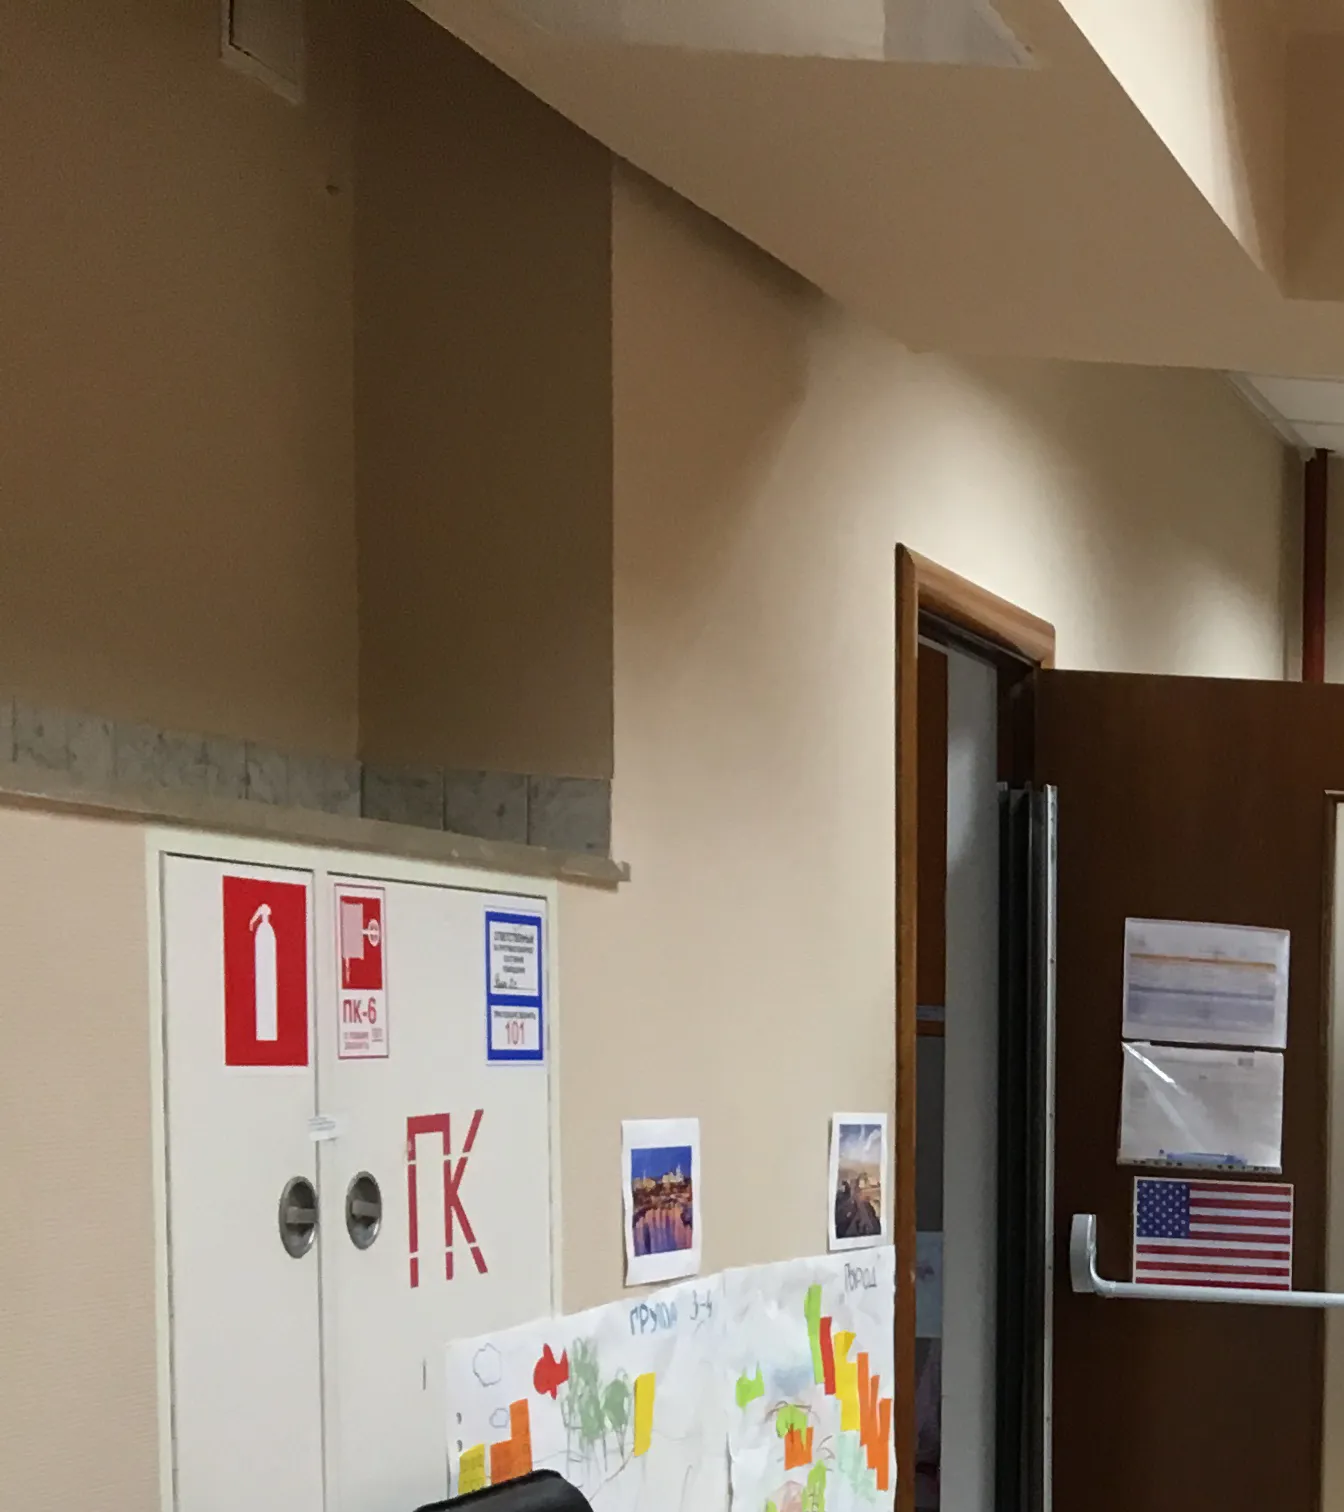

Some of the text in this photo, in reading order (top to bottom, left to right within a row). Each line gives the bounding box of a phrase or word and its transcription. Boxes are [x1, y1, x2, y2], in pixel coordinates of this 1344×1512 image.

[343, 996, 377, 1025] ПК-6
[505, 1020, 525, 1045] 101
[406, 1109, 489, 1288] ПК
